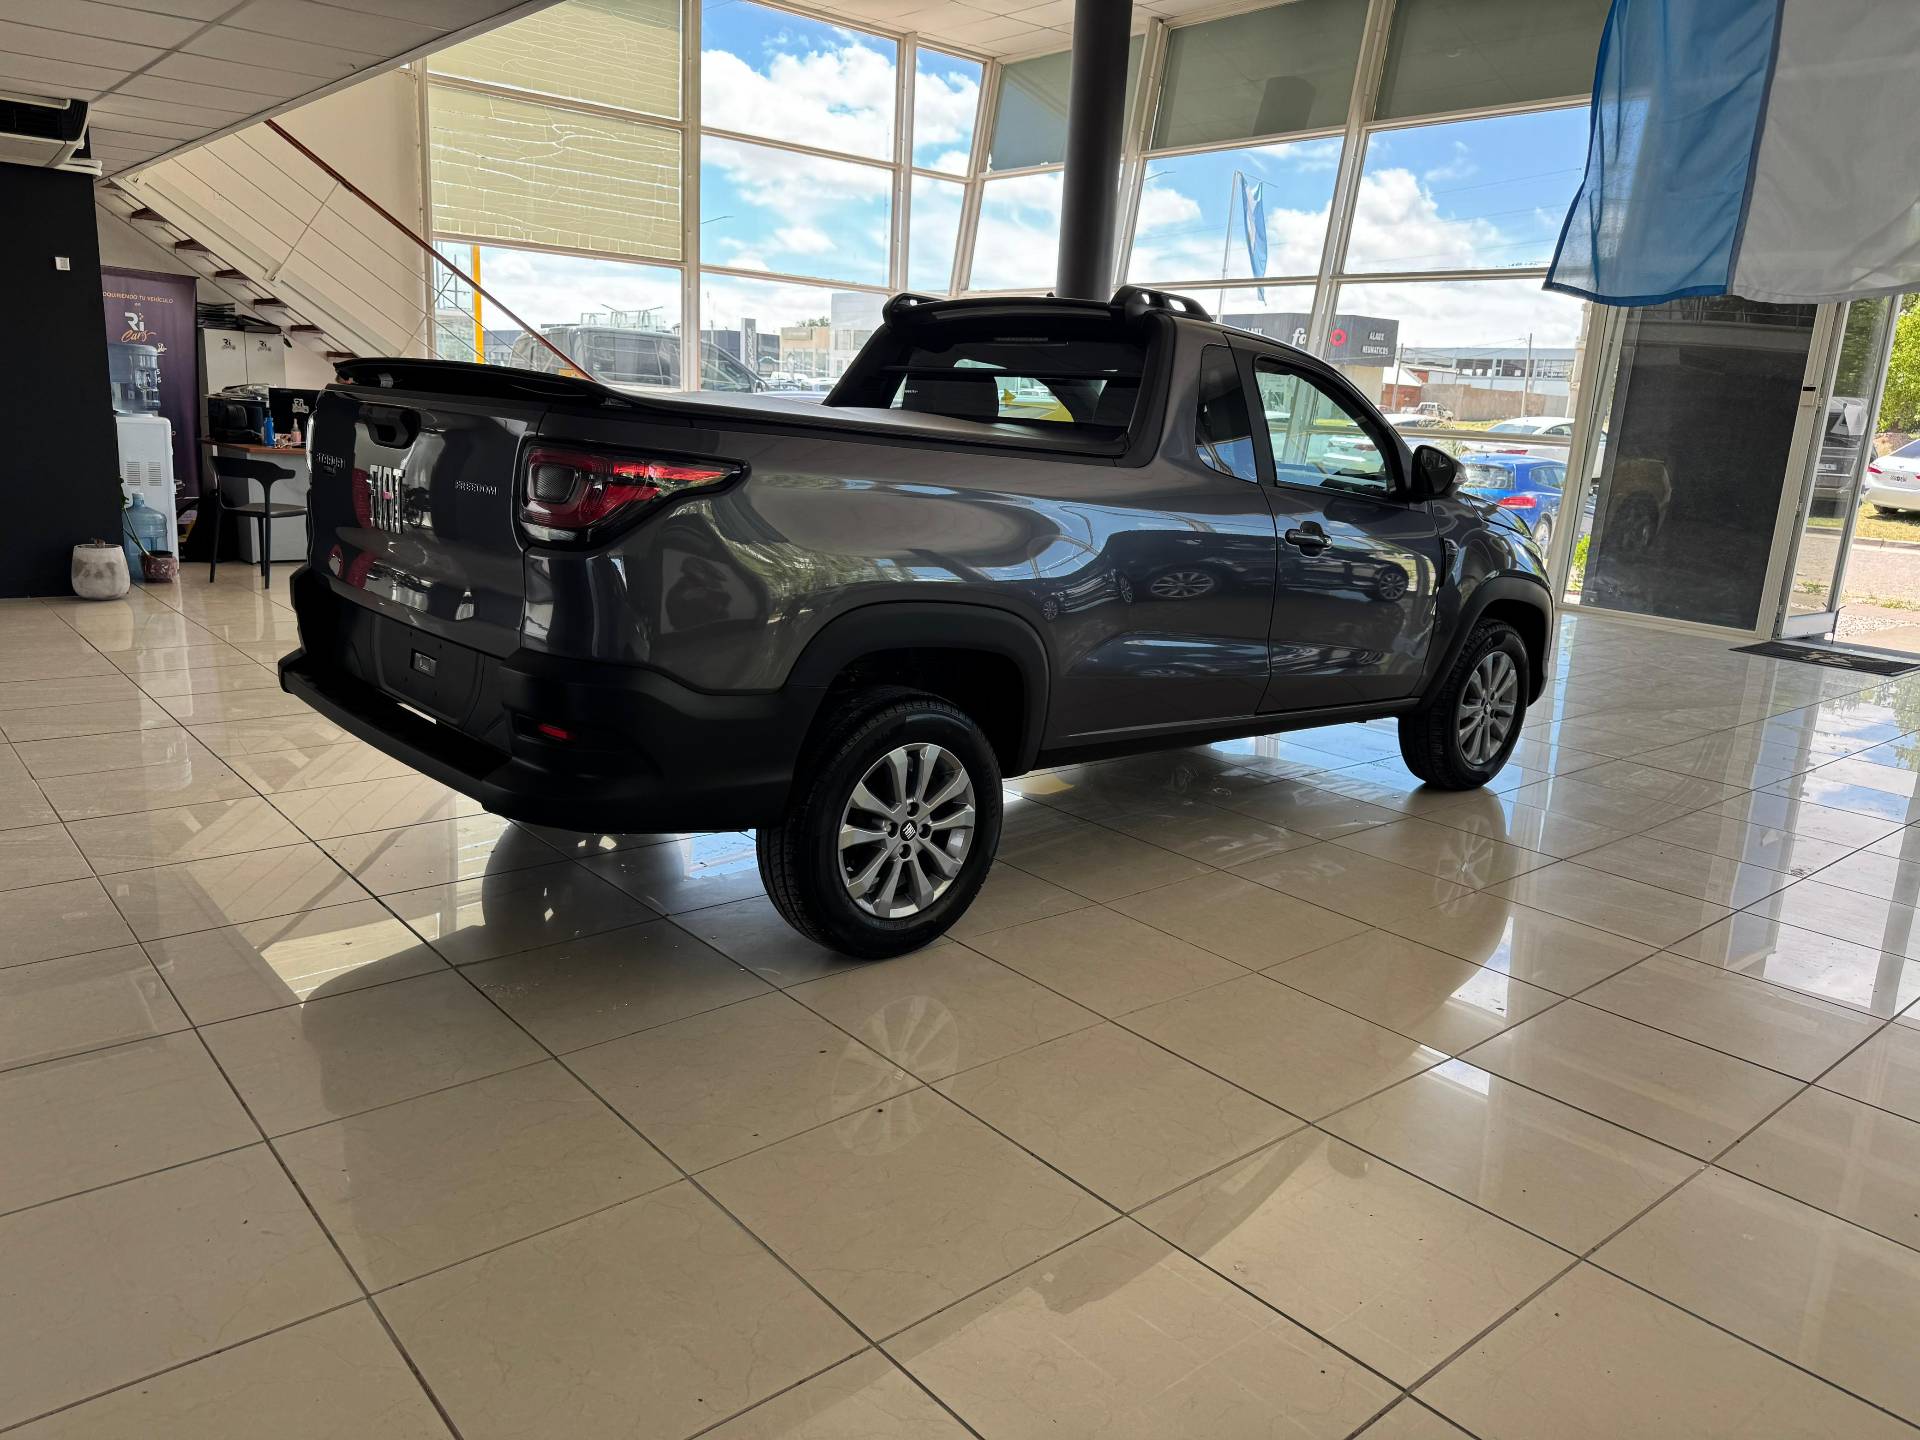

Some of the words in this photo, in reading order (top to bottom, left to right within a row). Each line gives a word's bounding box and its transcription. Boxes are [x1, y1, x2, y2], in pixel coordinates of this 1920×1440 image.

[102, 291, 138, 300] DQUIRIENDO
[121, 329, 157, 342] Cars
[455, 480, 498, 496] FREEDOM
[369, 464, 405, 534] FIAT
